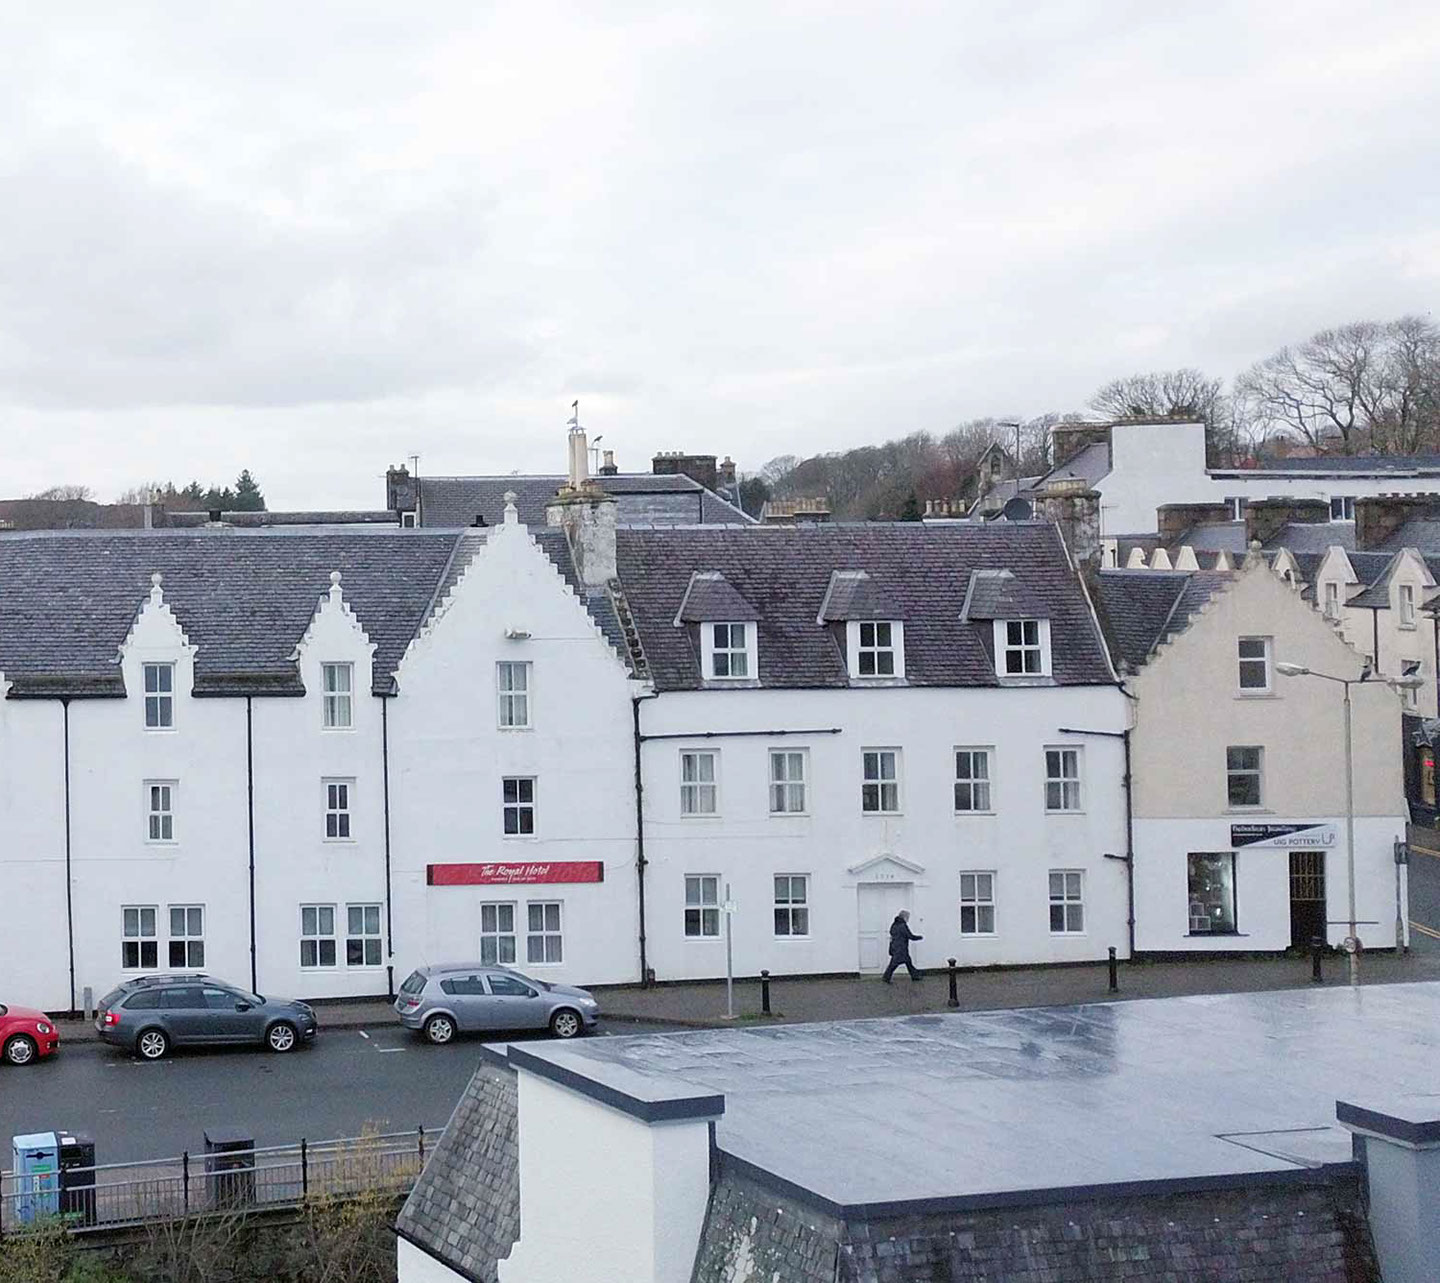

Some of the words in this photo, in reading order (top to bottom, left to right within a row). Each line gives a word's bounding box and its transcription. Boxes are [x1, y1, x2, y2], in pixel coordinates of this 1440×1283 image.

[481, 865, 495, 877] The
[496, 865, 525, 883] Royal
[525, 865, 550, 876] Hotel
